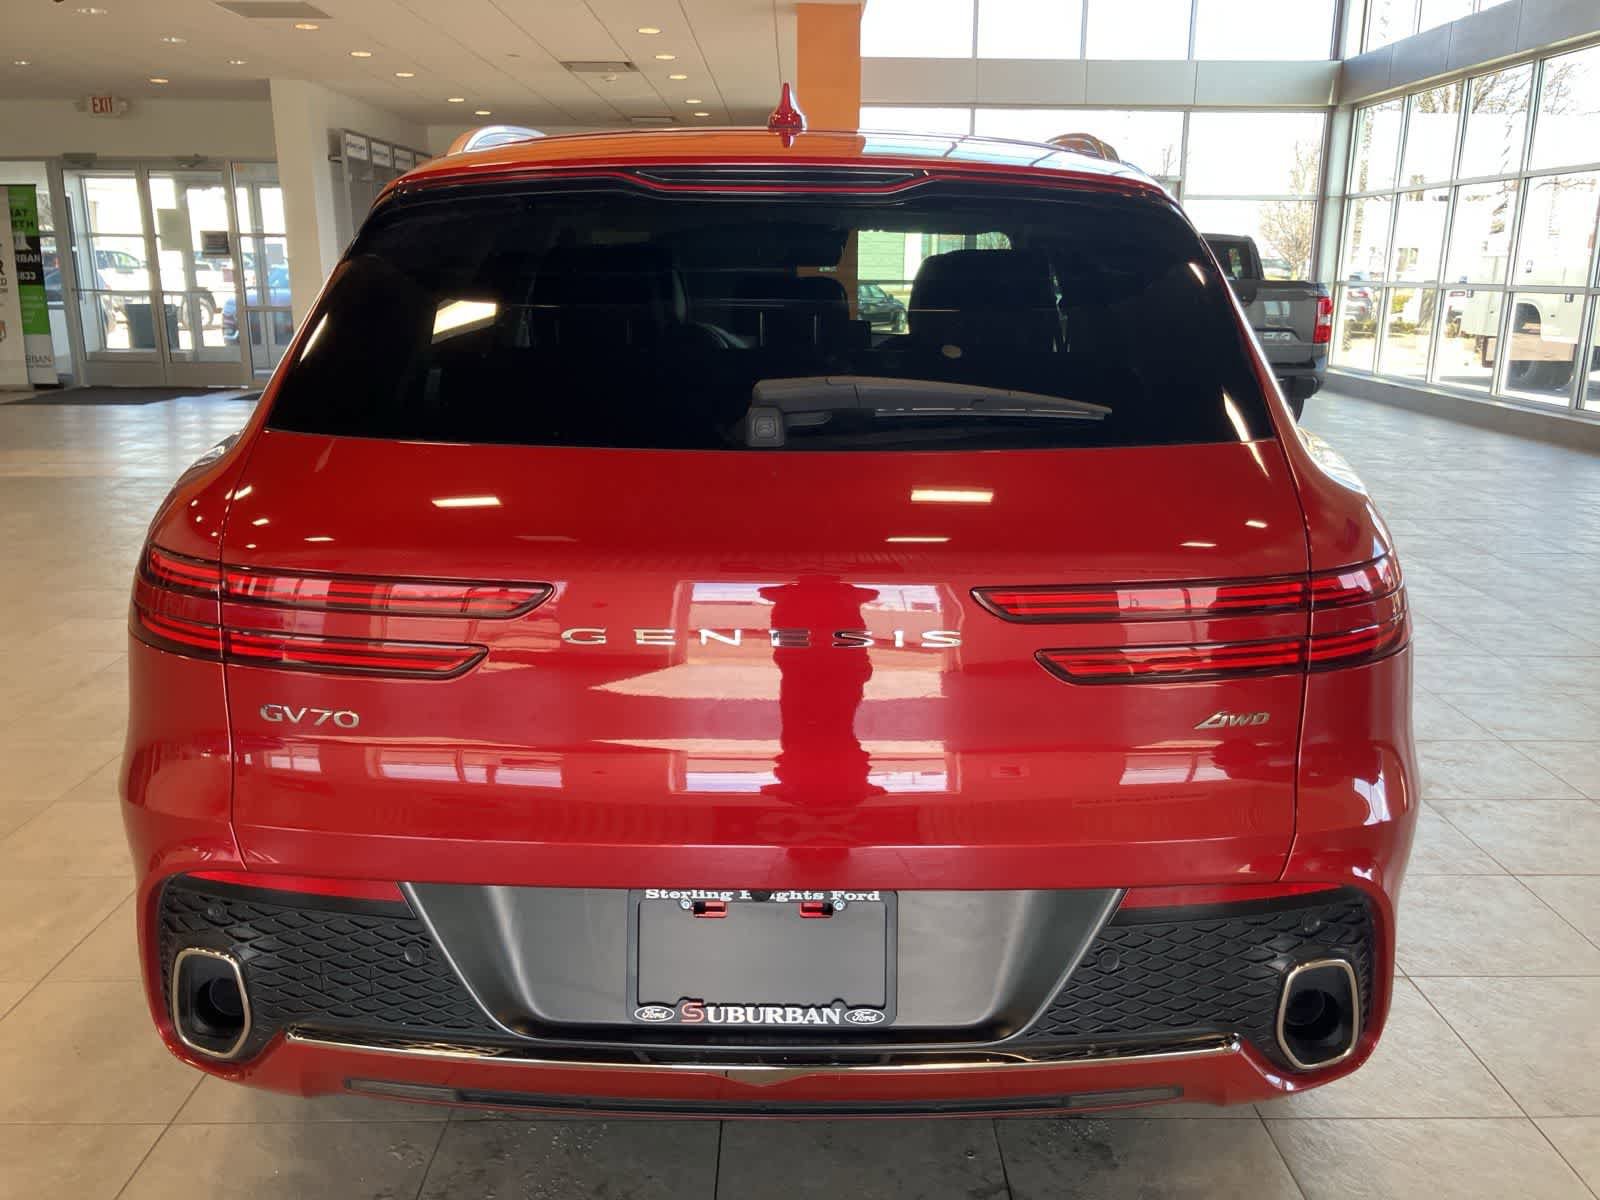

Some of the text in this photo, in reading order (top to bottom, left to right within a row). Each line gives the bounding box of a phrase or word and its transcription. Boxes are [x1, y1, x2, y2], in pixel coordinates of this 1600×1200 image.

[91, 96, 113, 113] EXIT
[560, 627, 962, 648] GENESIS
[259, 703, 361, 729] GV70
[1192, 711, 1270, 730] AWD
[645, 888, 733, 901] Sterling
[831, 890, 881, 902] Ford
[641, 1002, 878, 1025] Ford SUBURBAN Ford
